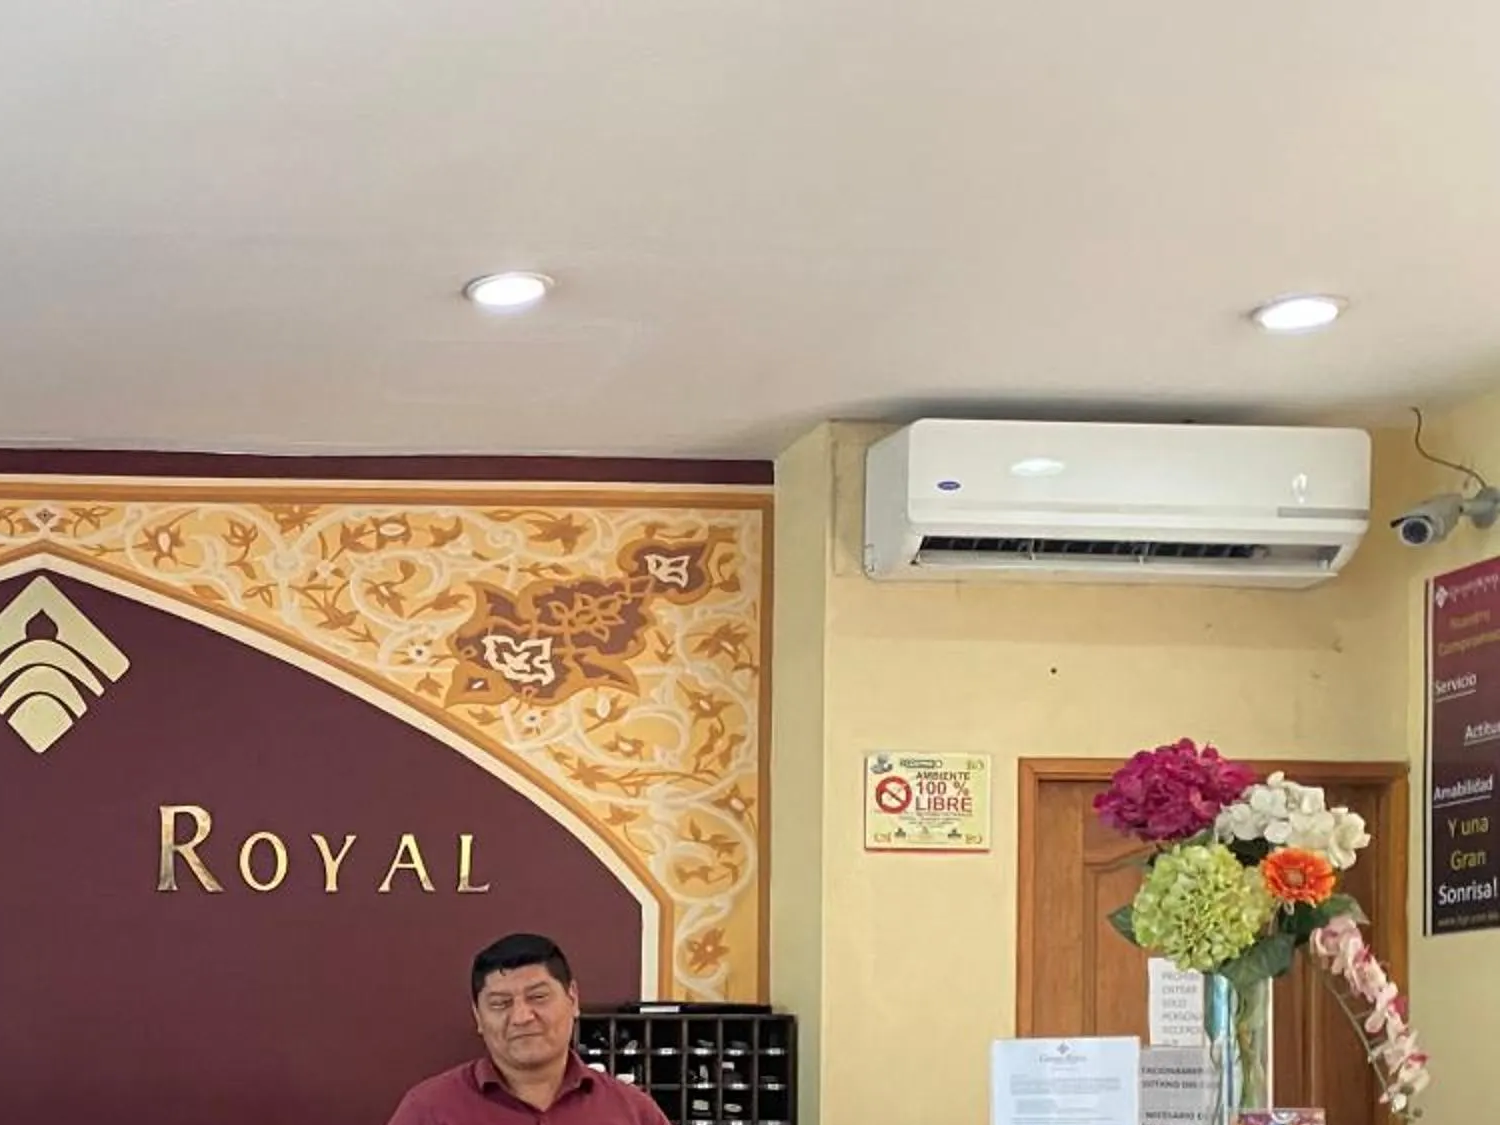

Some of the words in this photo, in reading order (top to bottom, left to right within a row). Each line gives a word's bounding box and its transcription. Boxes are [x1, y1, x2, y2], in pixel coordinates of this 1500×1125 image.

[1434, 671, 1477, 696] Servicio
[916, 772, 971, 781] AMBIENTE
[1434, 774, 1493, 801] Amabilidad
[916, 781, 947, 795] 100
[916, 797, 973, 812] LIBRE
[1447, 818, 1457, 839] Y
[1461, 816, 1489, 836] una
[157, 804, 490, 893] ROYAL
[1451, 850, 1486, 871] Gran
